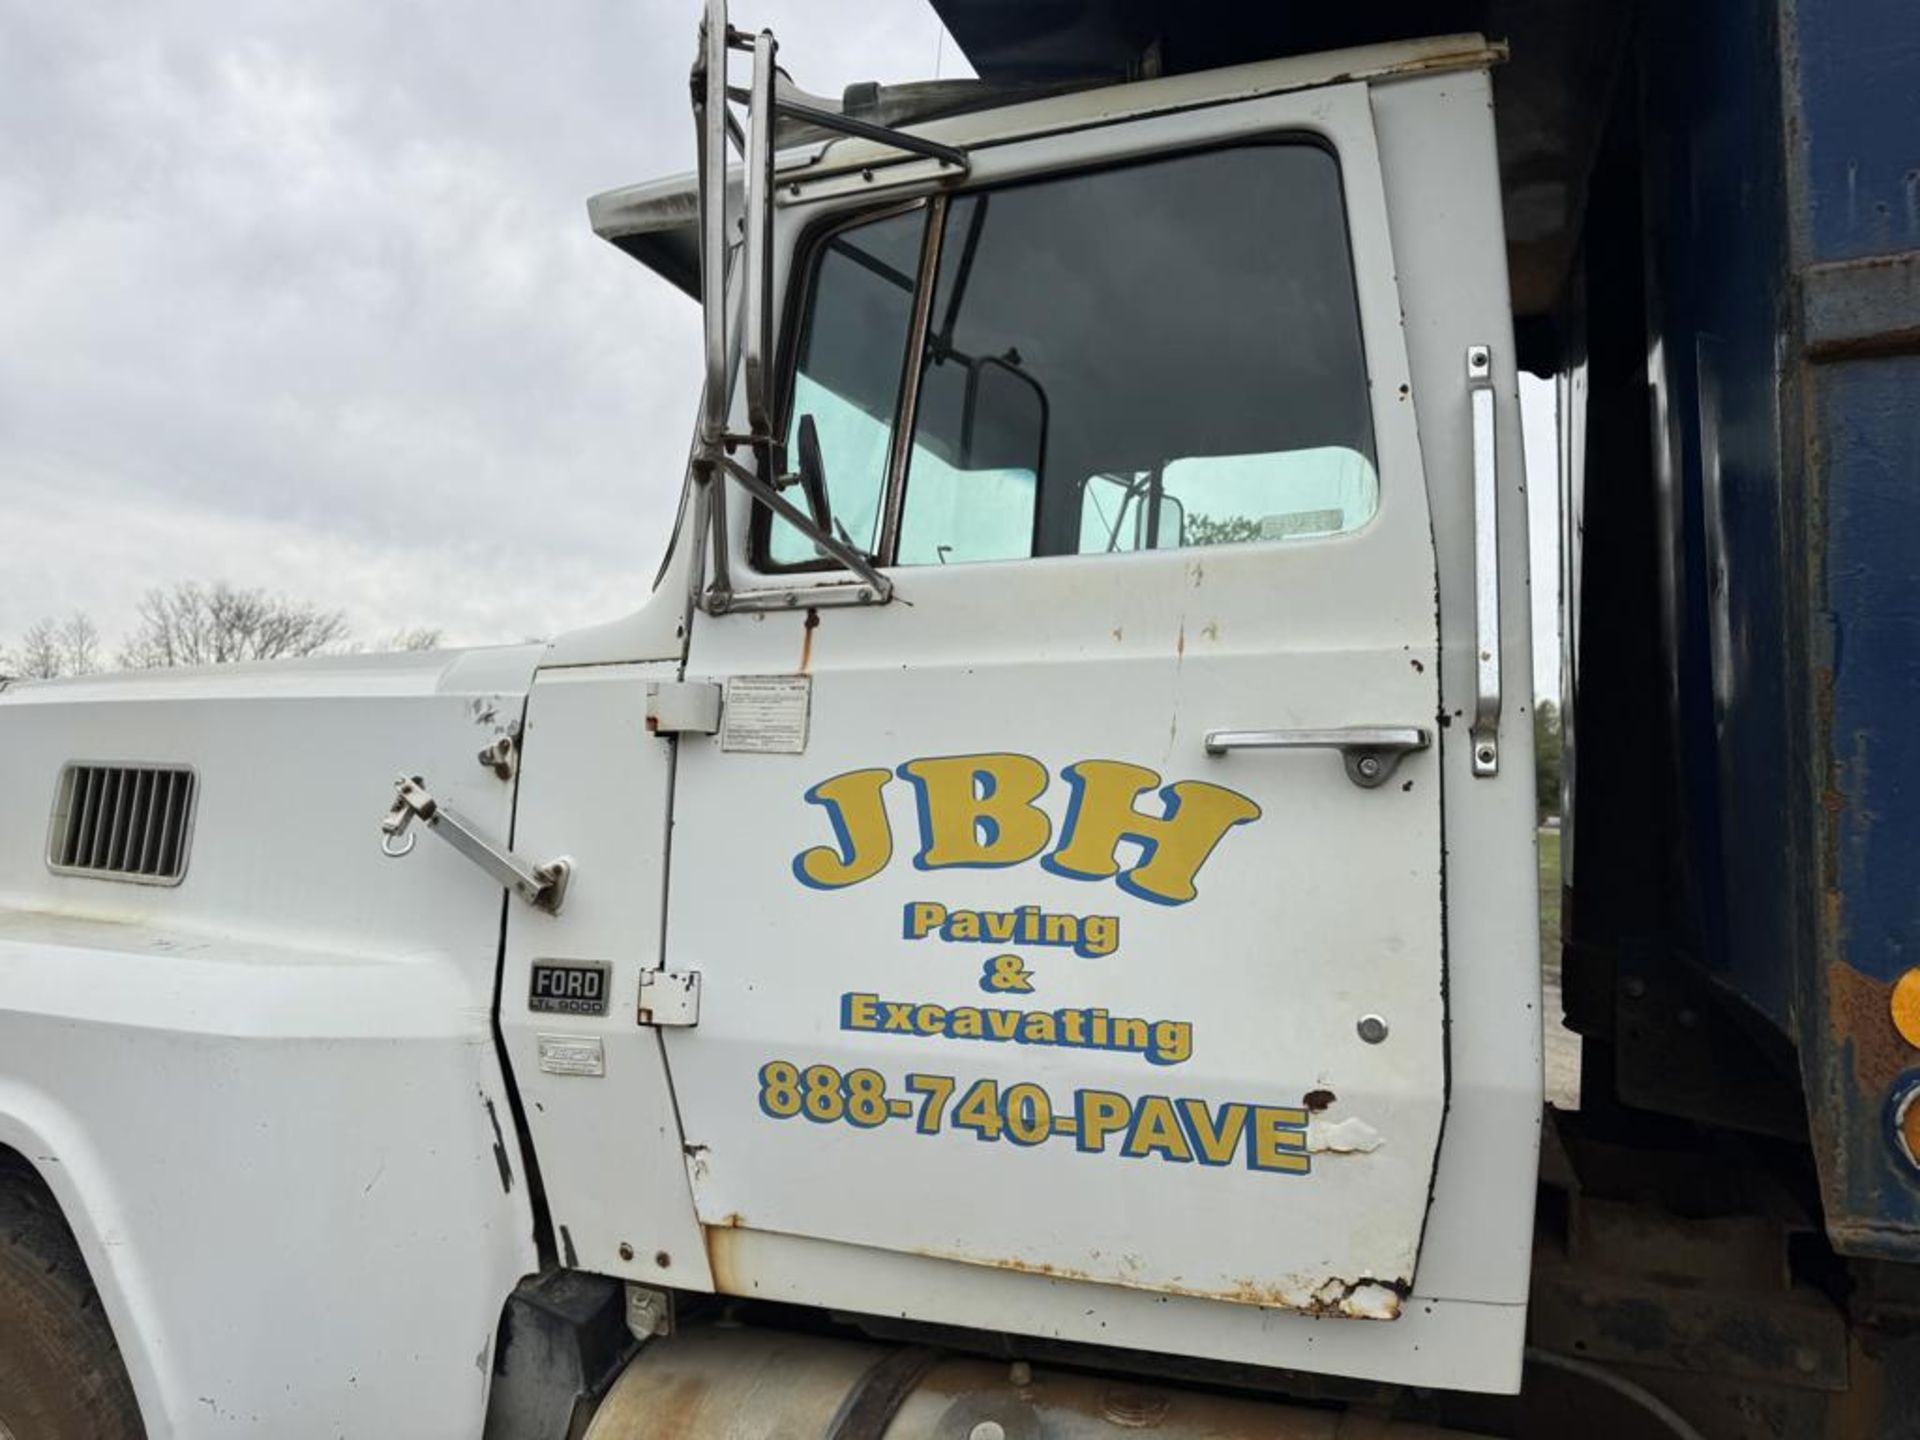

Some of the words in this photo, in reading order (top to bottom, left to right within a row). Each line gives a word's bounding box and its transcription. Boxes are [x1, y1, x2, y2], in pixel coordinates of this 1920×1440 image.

[792, 753, 1262, 906] JBH
[902, 901, 1120, 958] Paving
[537, 969, 599, 997] FORD
[979, 954, 1035, 994] &
[558, 1000, 603, 1012] 9000
[840, 993, 1193, 1066] Excavating
[758, 1061, 1312, 1175] 888-740-PAVE
